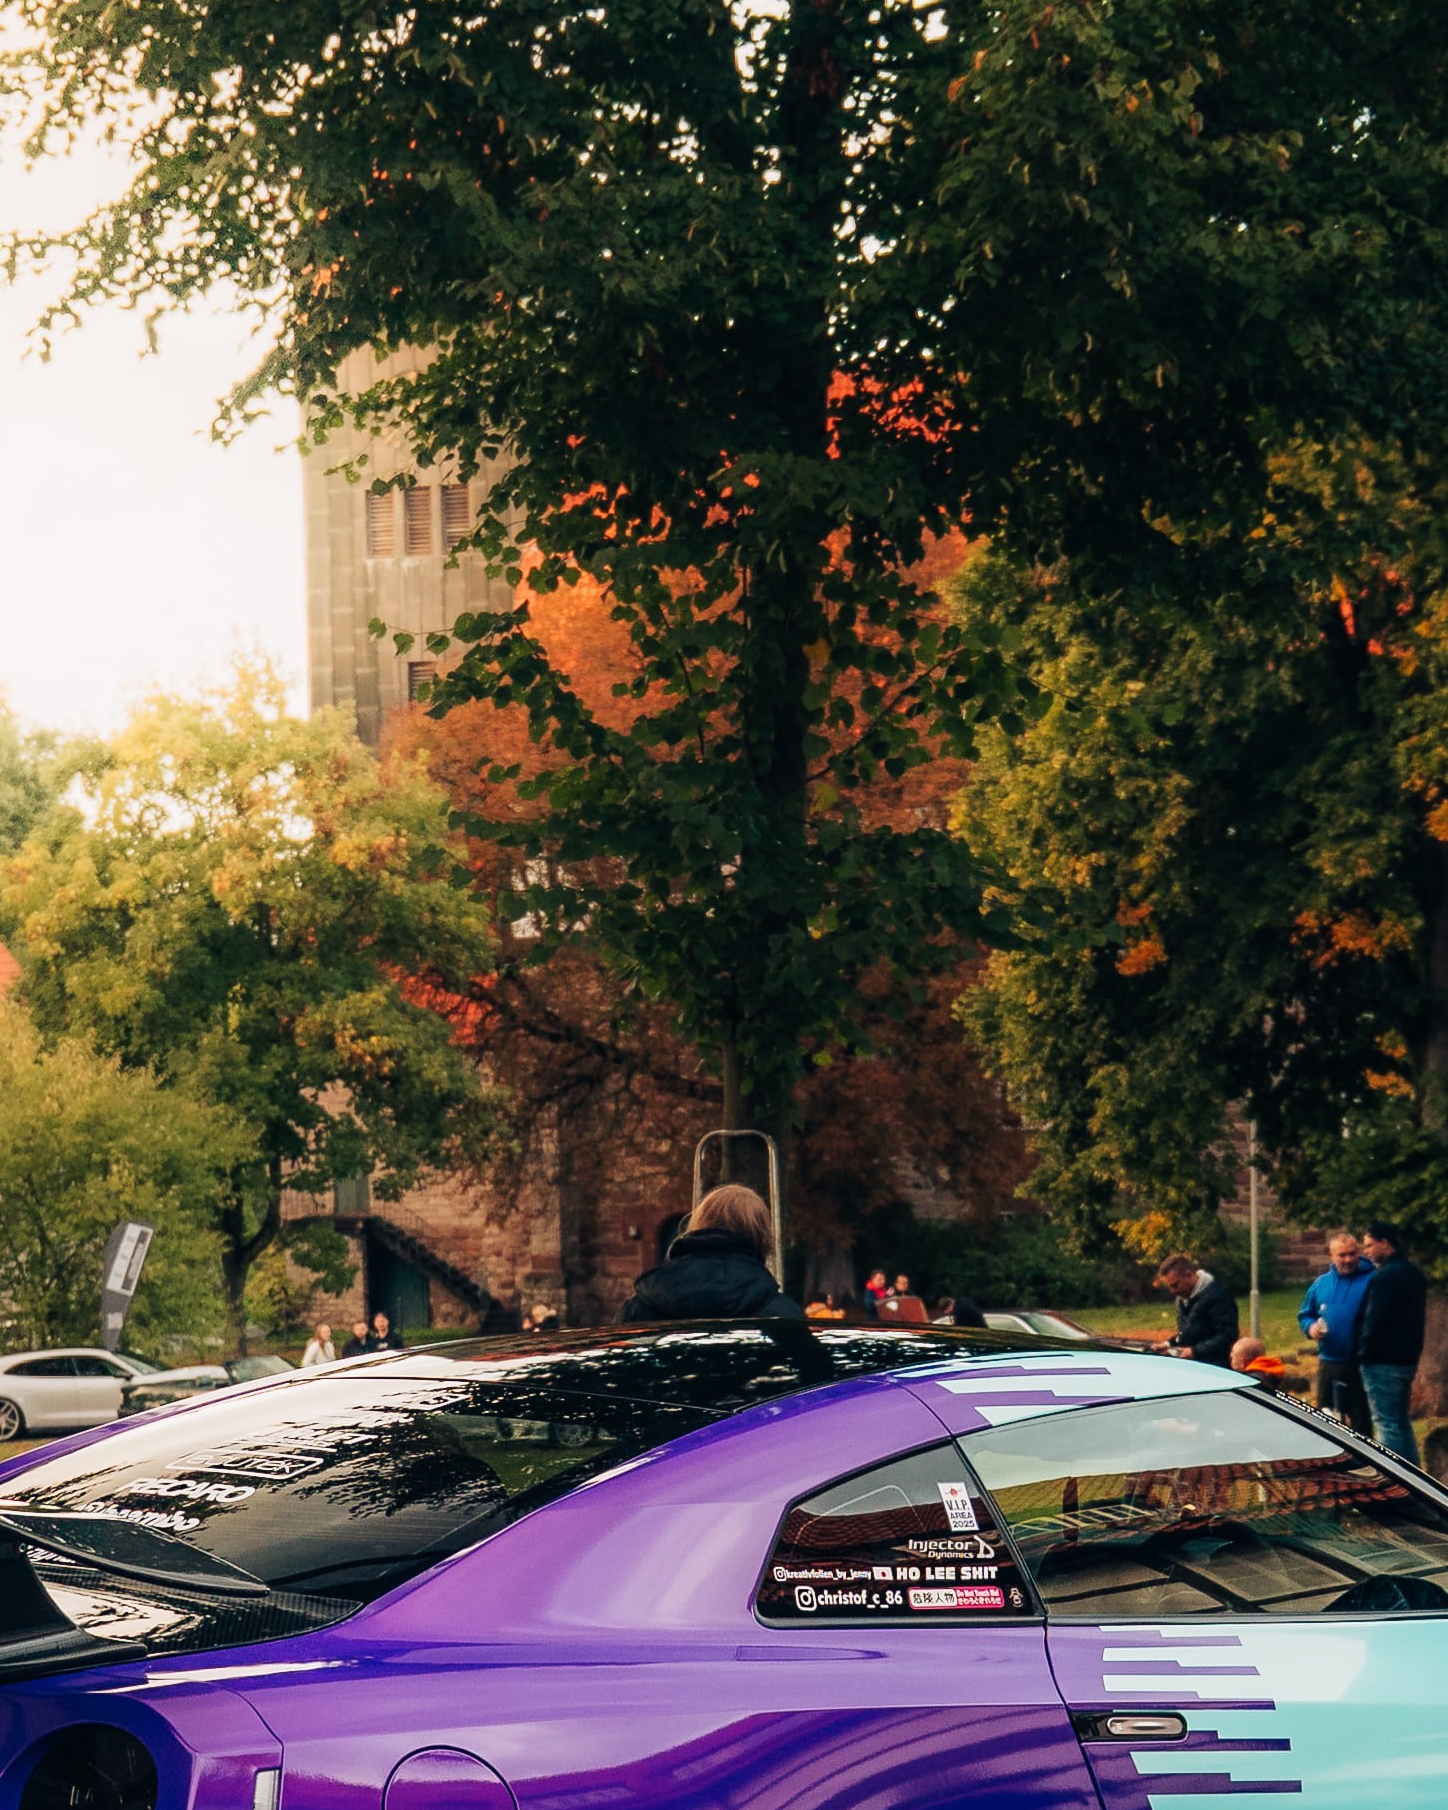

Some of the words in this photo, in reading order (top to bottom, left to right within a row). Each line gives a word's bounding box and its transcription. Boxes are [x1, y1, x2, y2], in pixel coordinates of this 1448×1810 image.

[115, 1476, 256, 1503] RECARO
[950, 1511, 973, 1519] AREA
[908, 1539, 973, 1552] Injector
[928, 1550, 974, 1560] Dynamics
[896, 1566, 921, 1580] HO
[925, 1566, 956, 1580] LEE
[960, 1566, 998, 1580] SHIT
[817, 1589, 903, 1608] christof_c_86
